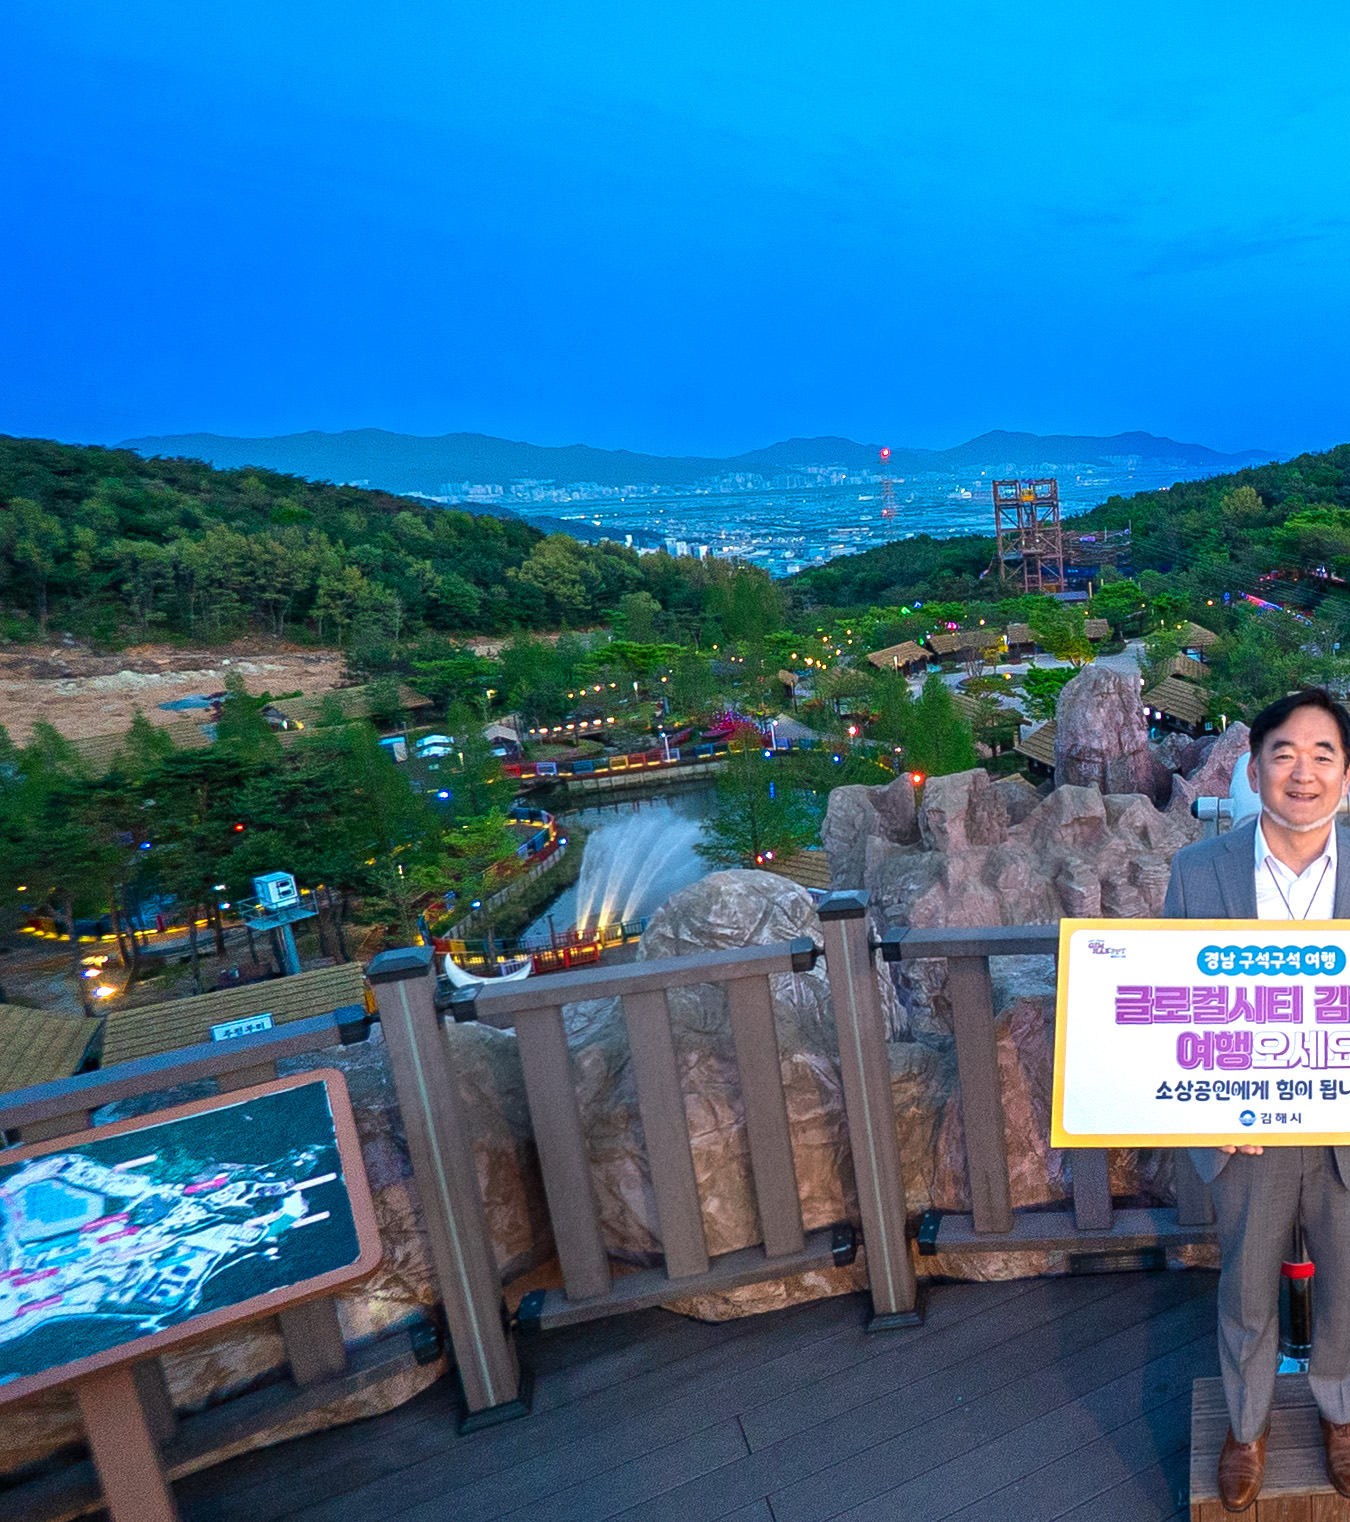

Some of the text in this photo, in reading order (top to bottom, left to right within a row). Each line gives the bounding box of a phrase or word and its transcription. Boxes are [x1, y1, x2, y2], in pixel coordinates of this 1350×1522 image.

[1204, 951, 1336, 970] 경남 구석구석 여행
[1115, 985, 1303, 1024] 글로컬시티
[1155, 1079, 1270, 1102] 소상공인에게
[1276, 1079, 1313, 1101] 힘이
[1260, 1112, 1302, 1125] 김해시
